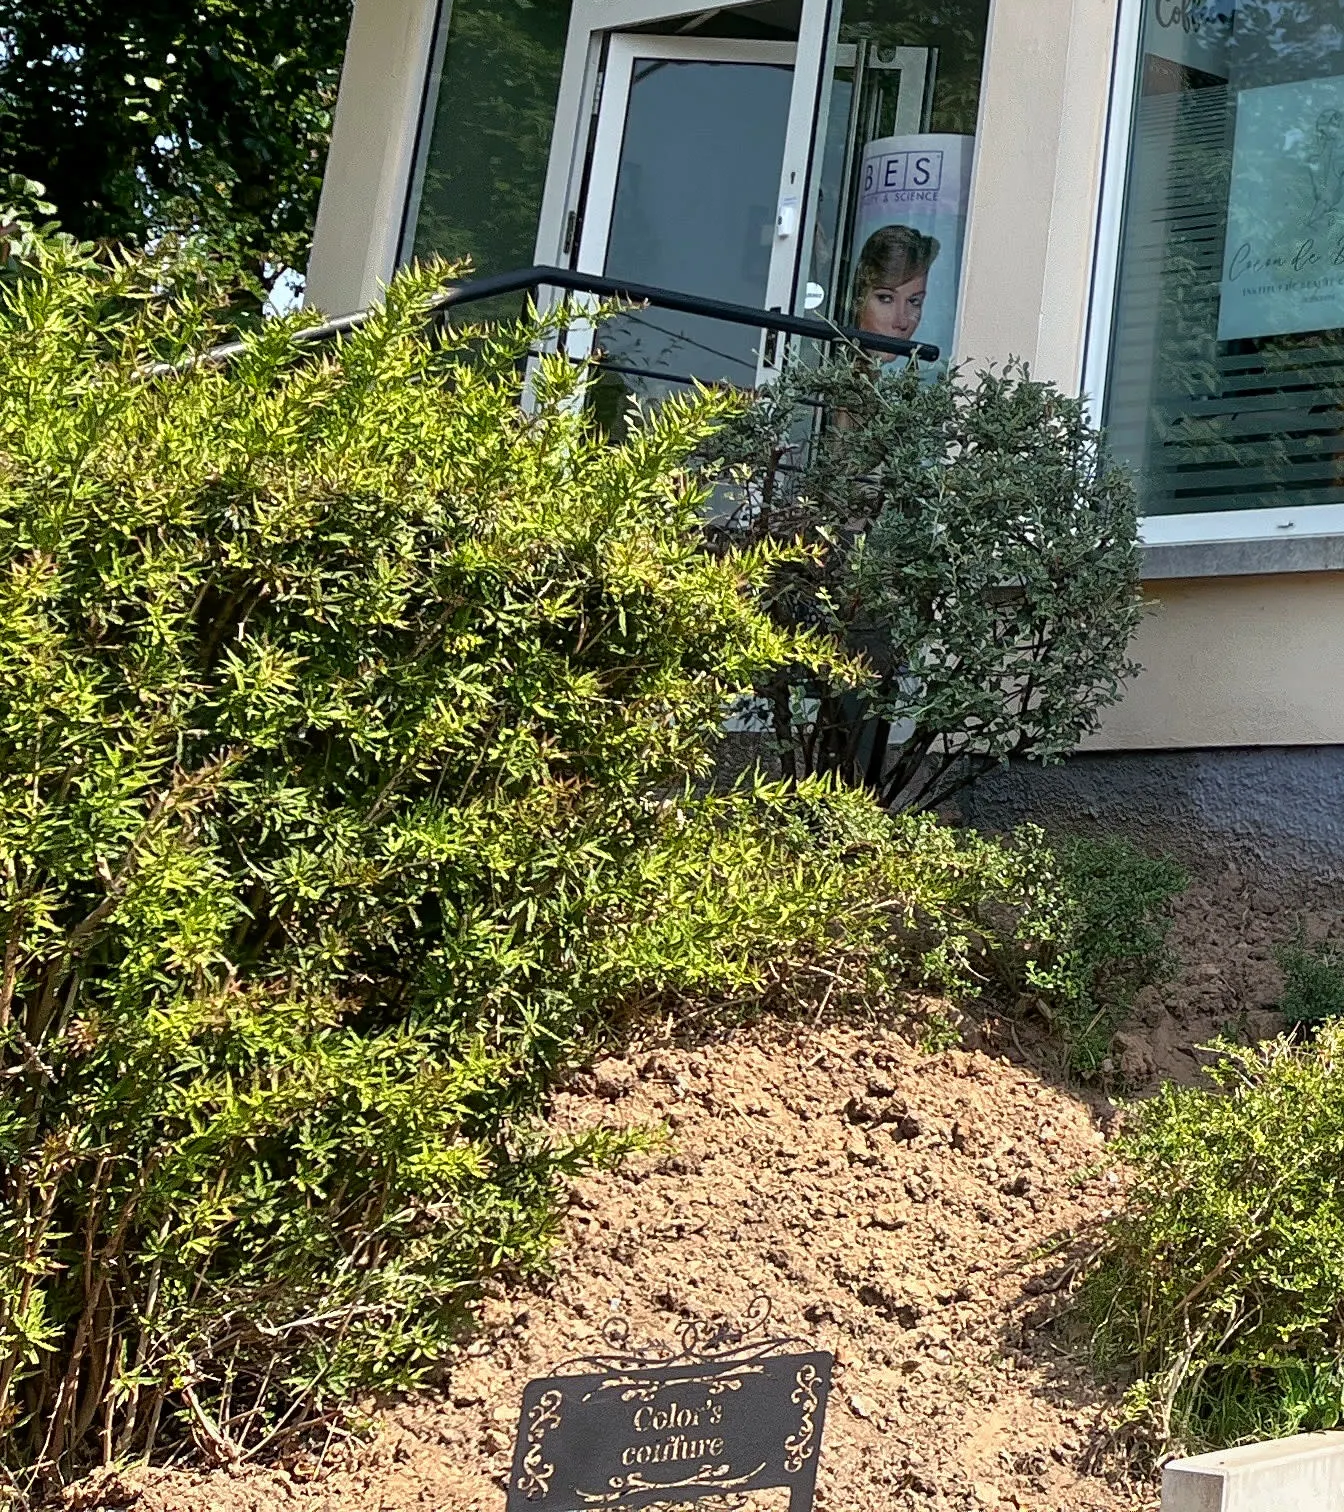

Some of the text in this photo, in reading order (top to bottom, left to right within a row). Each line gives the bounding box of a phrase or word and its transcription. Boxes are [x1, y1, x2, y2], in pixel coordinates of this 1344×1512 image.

[863, 156, 931, 192] BES
[895, 191, 939, 202] SCIENCE
[1290, 238, 1321, 272] de
[633, 1399, 723, 1431] Color's
